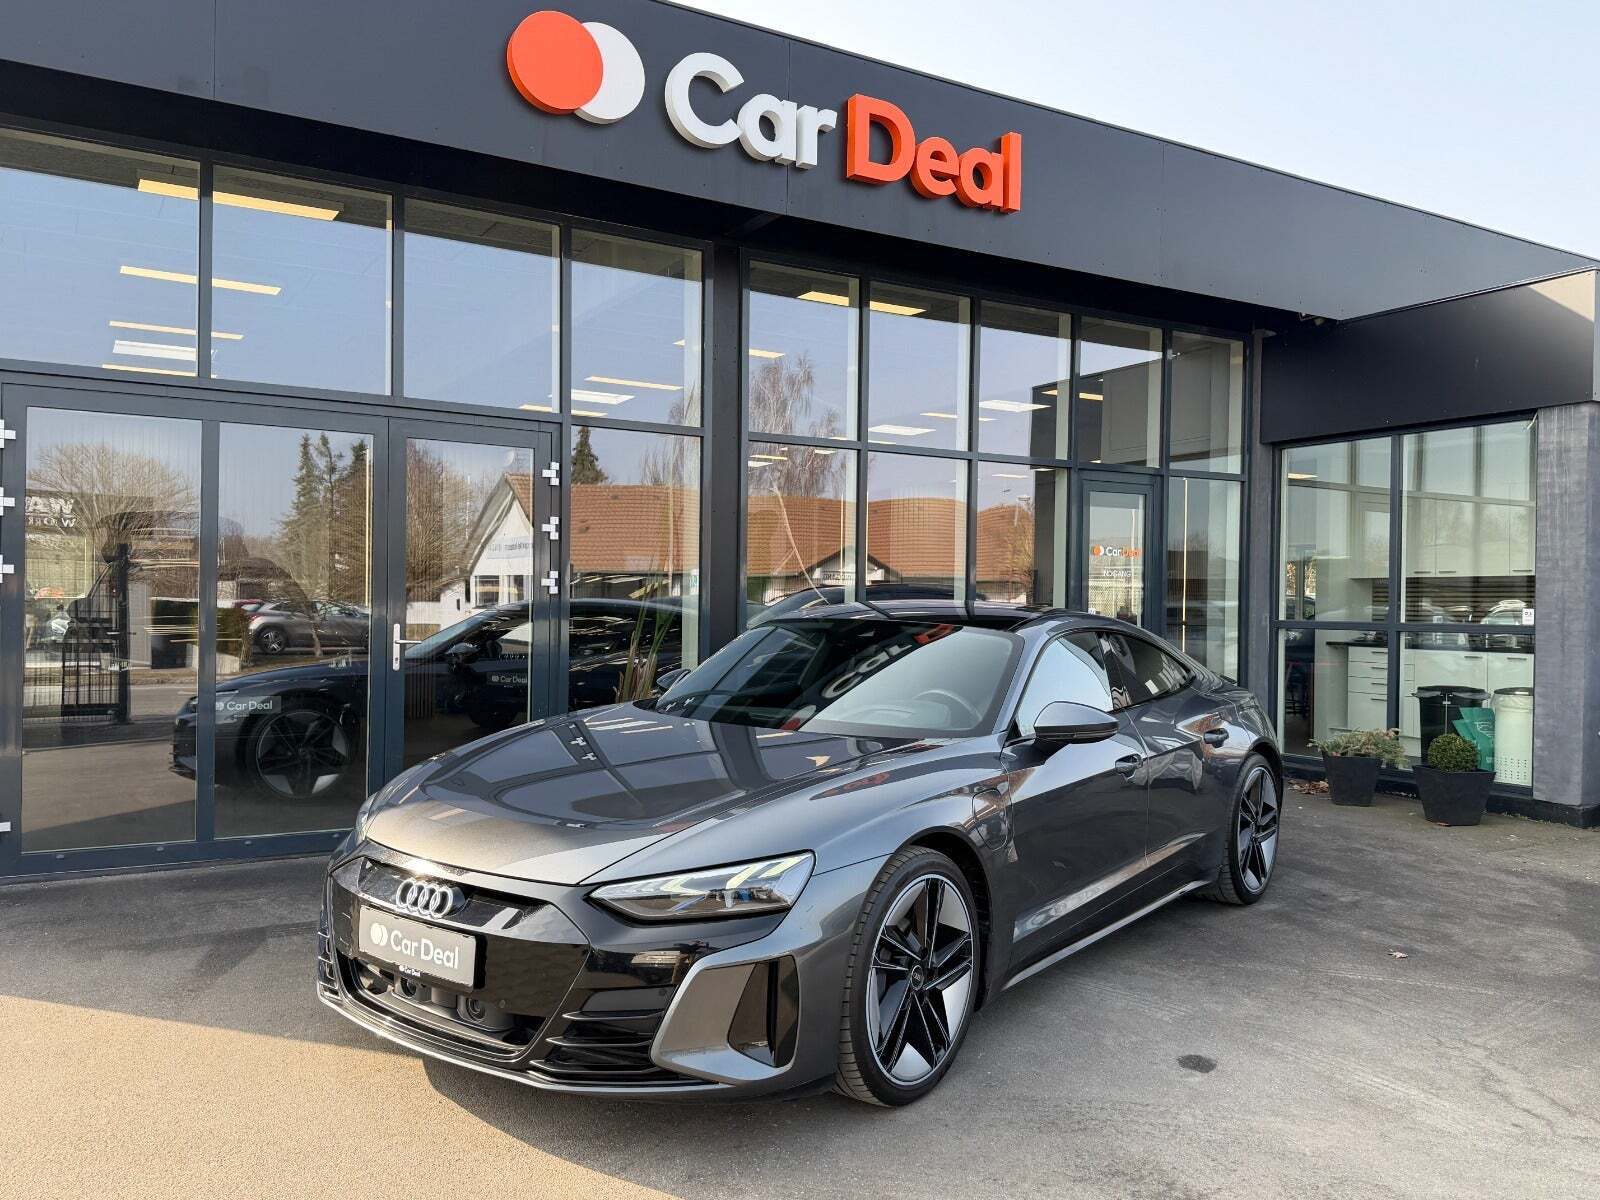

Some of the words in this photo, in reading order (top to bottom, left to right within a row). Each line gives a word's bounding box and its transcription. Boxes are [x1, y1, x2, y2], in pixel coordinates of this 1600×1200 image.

[664, 52, 837, 170] Car
[846, 93, 1022, 214] Deal
[1106, 546, 1121, 557] Car
[226, 701, 247, 711] Car
[248, 700, 273, 710] Deal
[390, 929, 418, 957] Car
[420, 938, 459, 970] Deal
